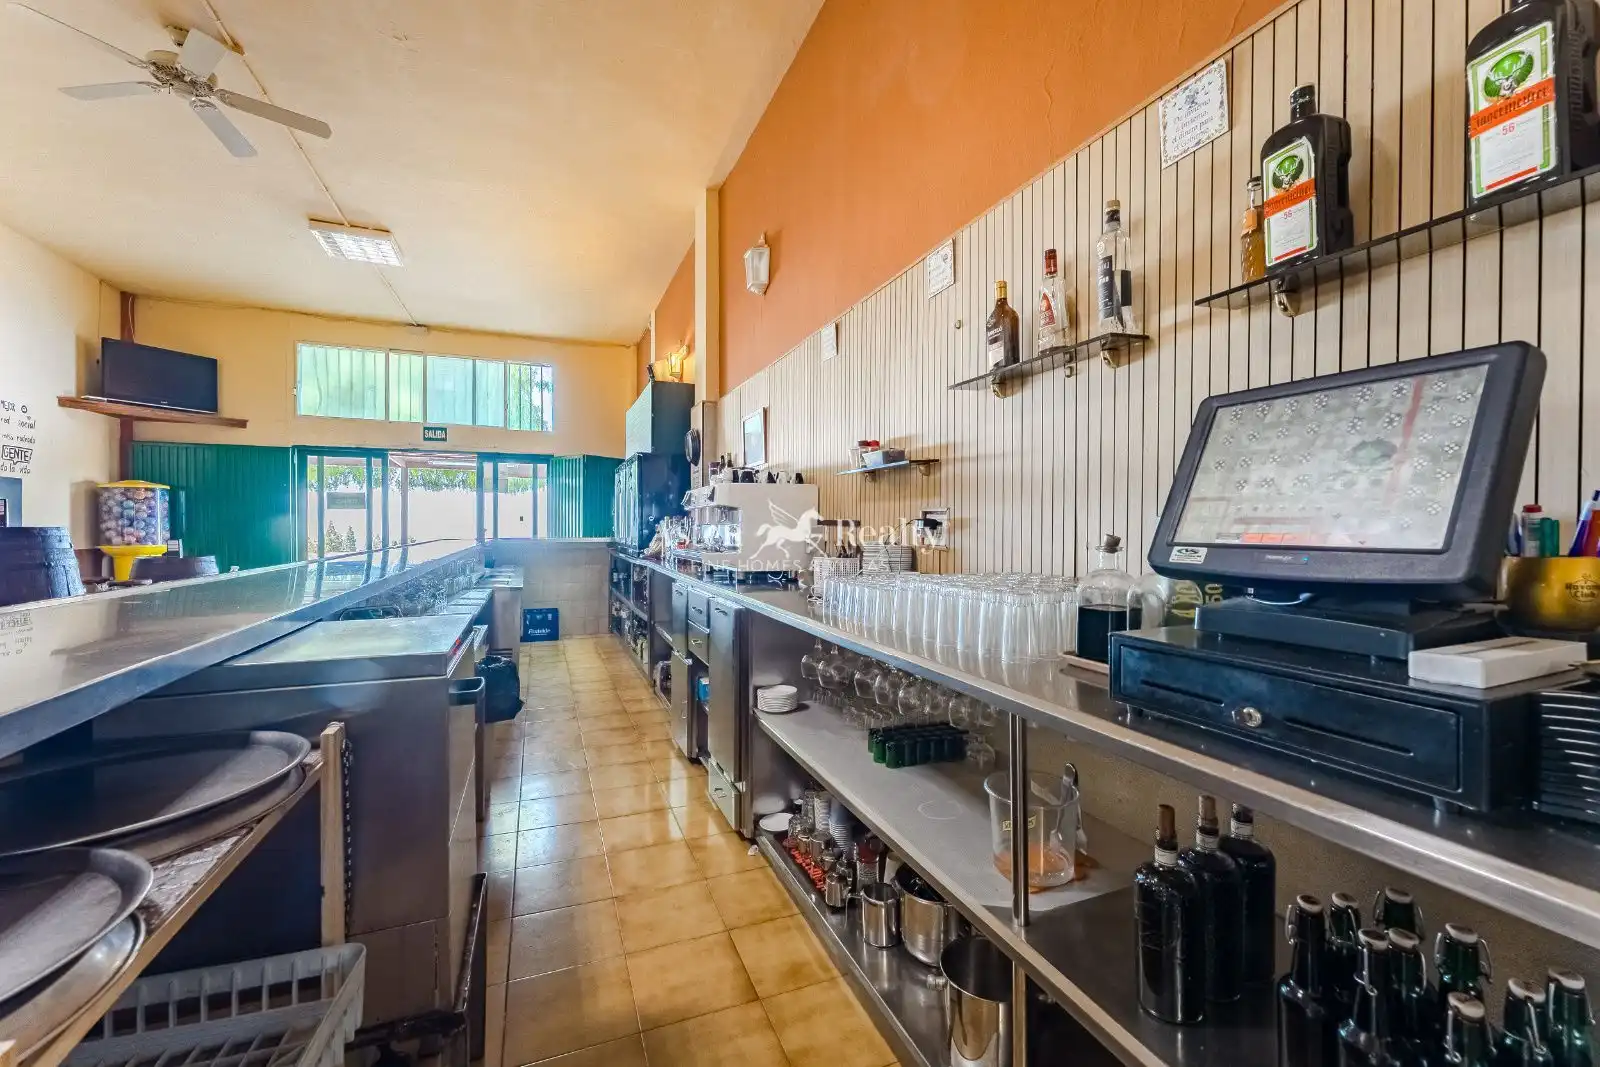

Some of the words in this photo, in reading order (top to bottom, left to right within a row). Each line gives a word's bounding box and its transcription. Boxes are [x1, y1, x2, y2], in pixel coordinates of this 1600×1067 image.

[424, 430, 446, 439] SALIDA
[4, 447, 30, 461] GENTE
[1566, 582, 1600, 590] Havan
